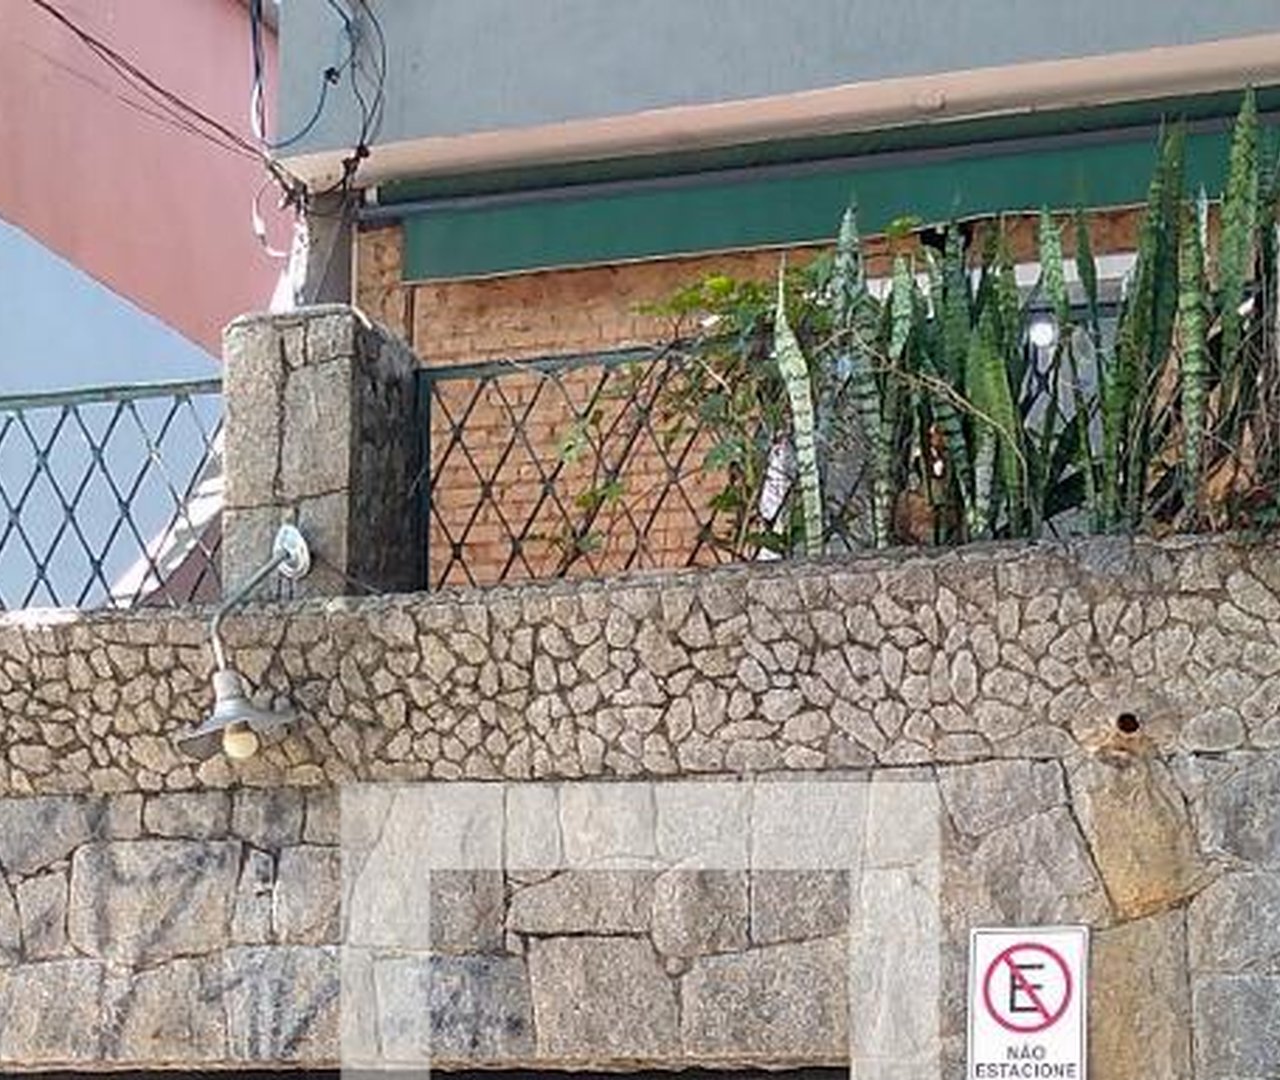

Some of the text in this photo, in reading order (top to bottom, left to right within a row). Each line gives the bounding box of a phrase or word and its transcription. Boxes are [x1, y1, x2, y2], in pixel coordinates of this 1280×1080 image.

[1010, 963, 1044, 1013] E
[1006, 1042, 1046, 1060] NÃO
[975, 1063, 1077, 1079] ESTACIONE
